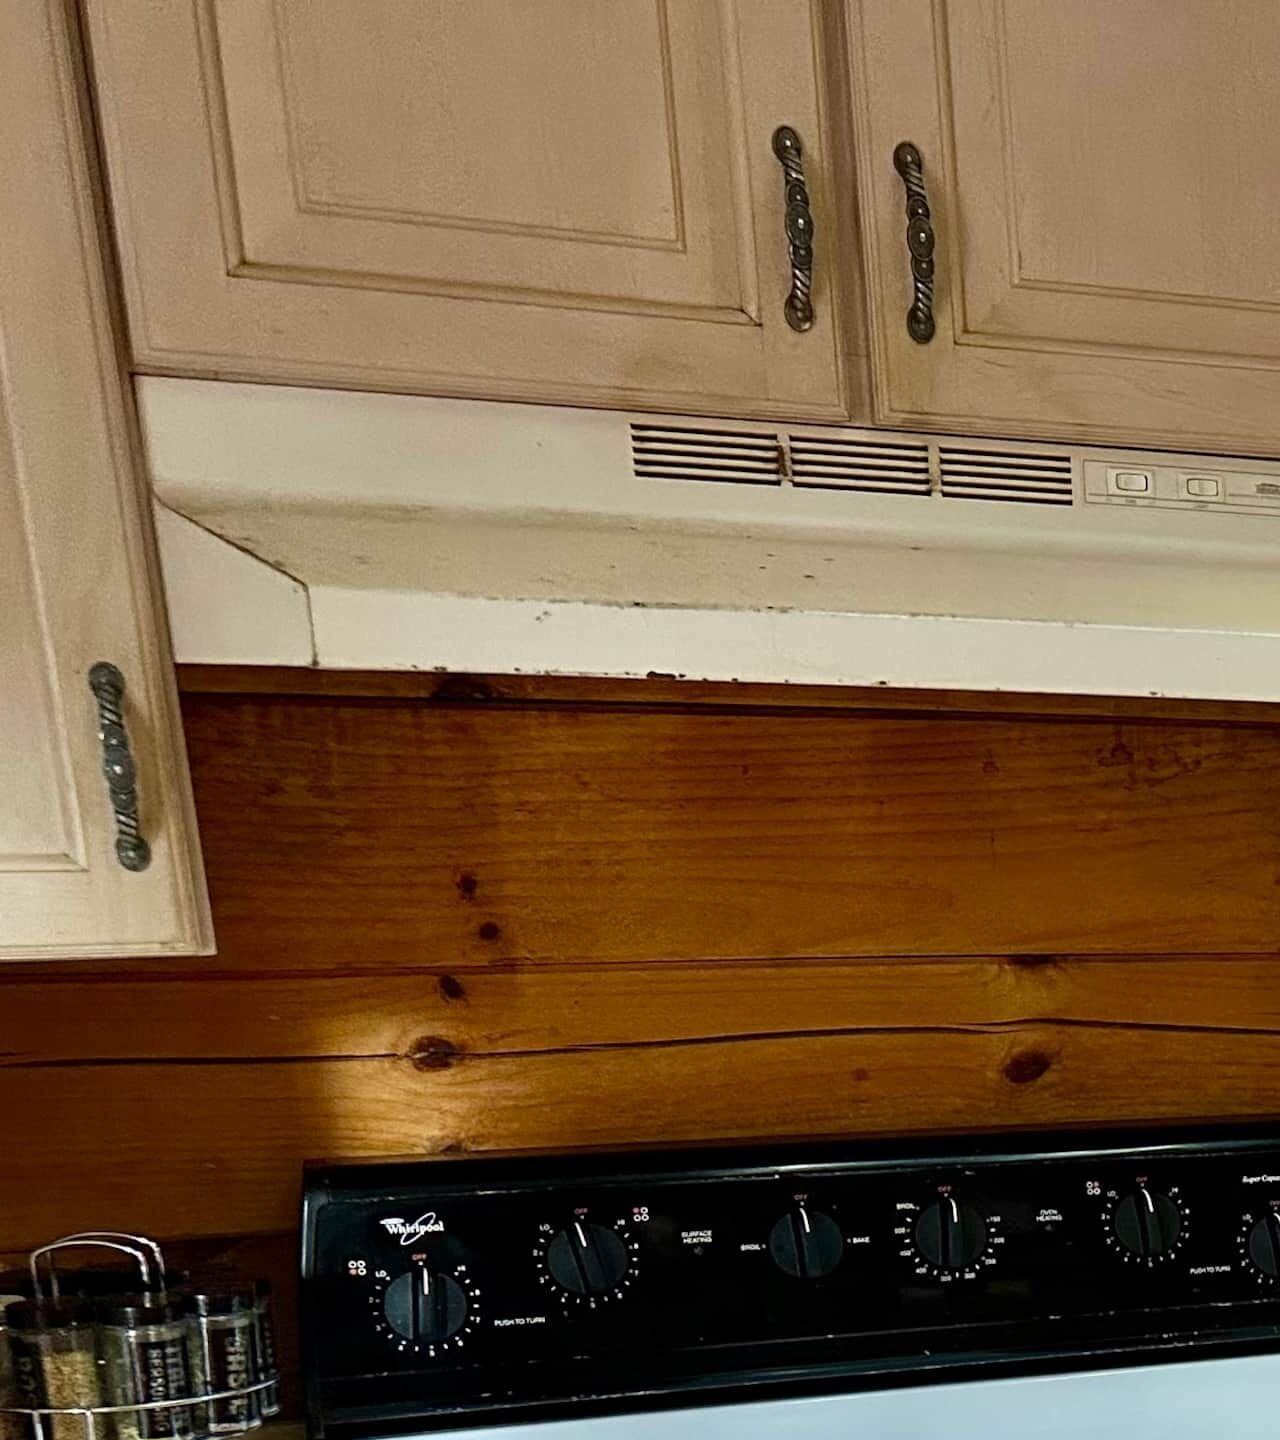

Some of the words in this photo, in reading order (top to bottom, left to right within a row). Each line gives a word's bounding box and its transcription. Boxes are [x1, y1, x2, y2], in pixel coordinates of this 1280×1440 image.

[380, 1215, 444, 1239] Whirlpool
[681, 1230, 712, 1238] SURFACE
[682, 1236, 712, 1244] HEATING
